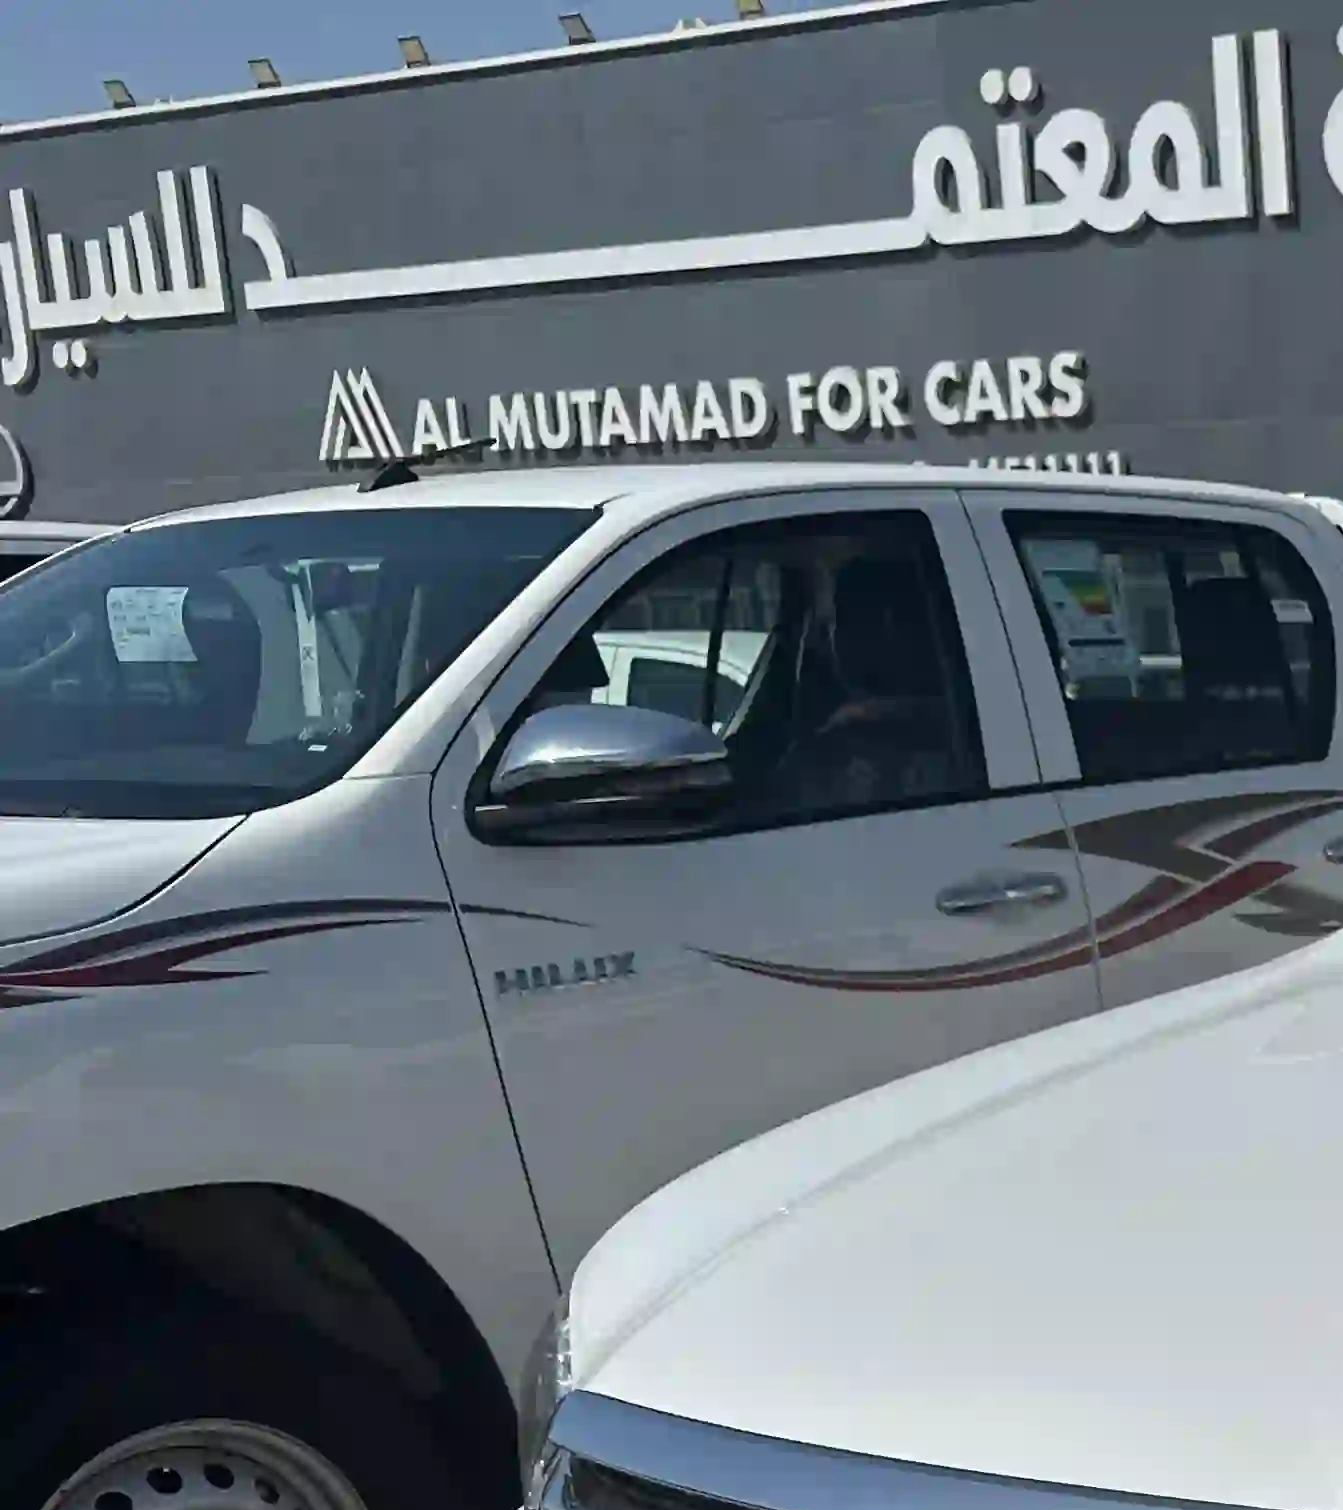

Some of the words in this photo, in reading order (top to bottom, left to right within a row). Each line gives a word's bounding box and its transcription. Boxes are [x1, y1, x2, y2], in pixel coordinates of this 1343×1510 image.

[242, 28, 1289, 310] المعتمد
[412, 396, 473, 455] AL
[489, 378, 767, 452] MUTAMAD
[787, 365, 909, 434] FOR
[924, 351, 1084, 425] CARS
